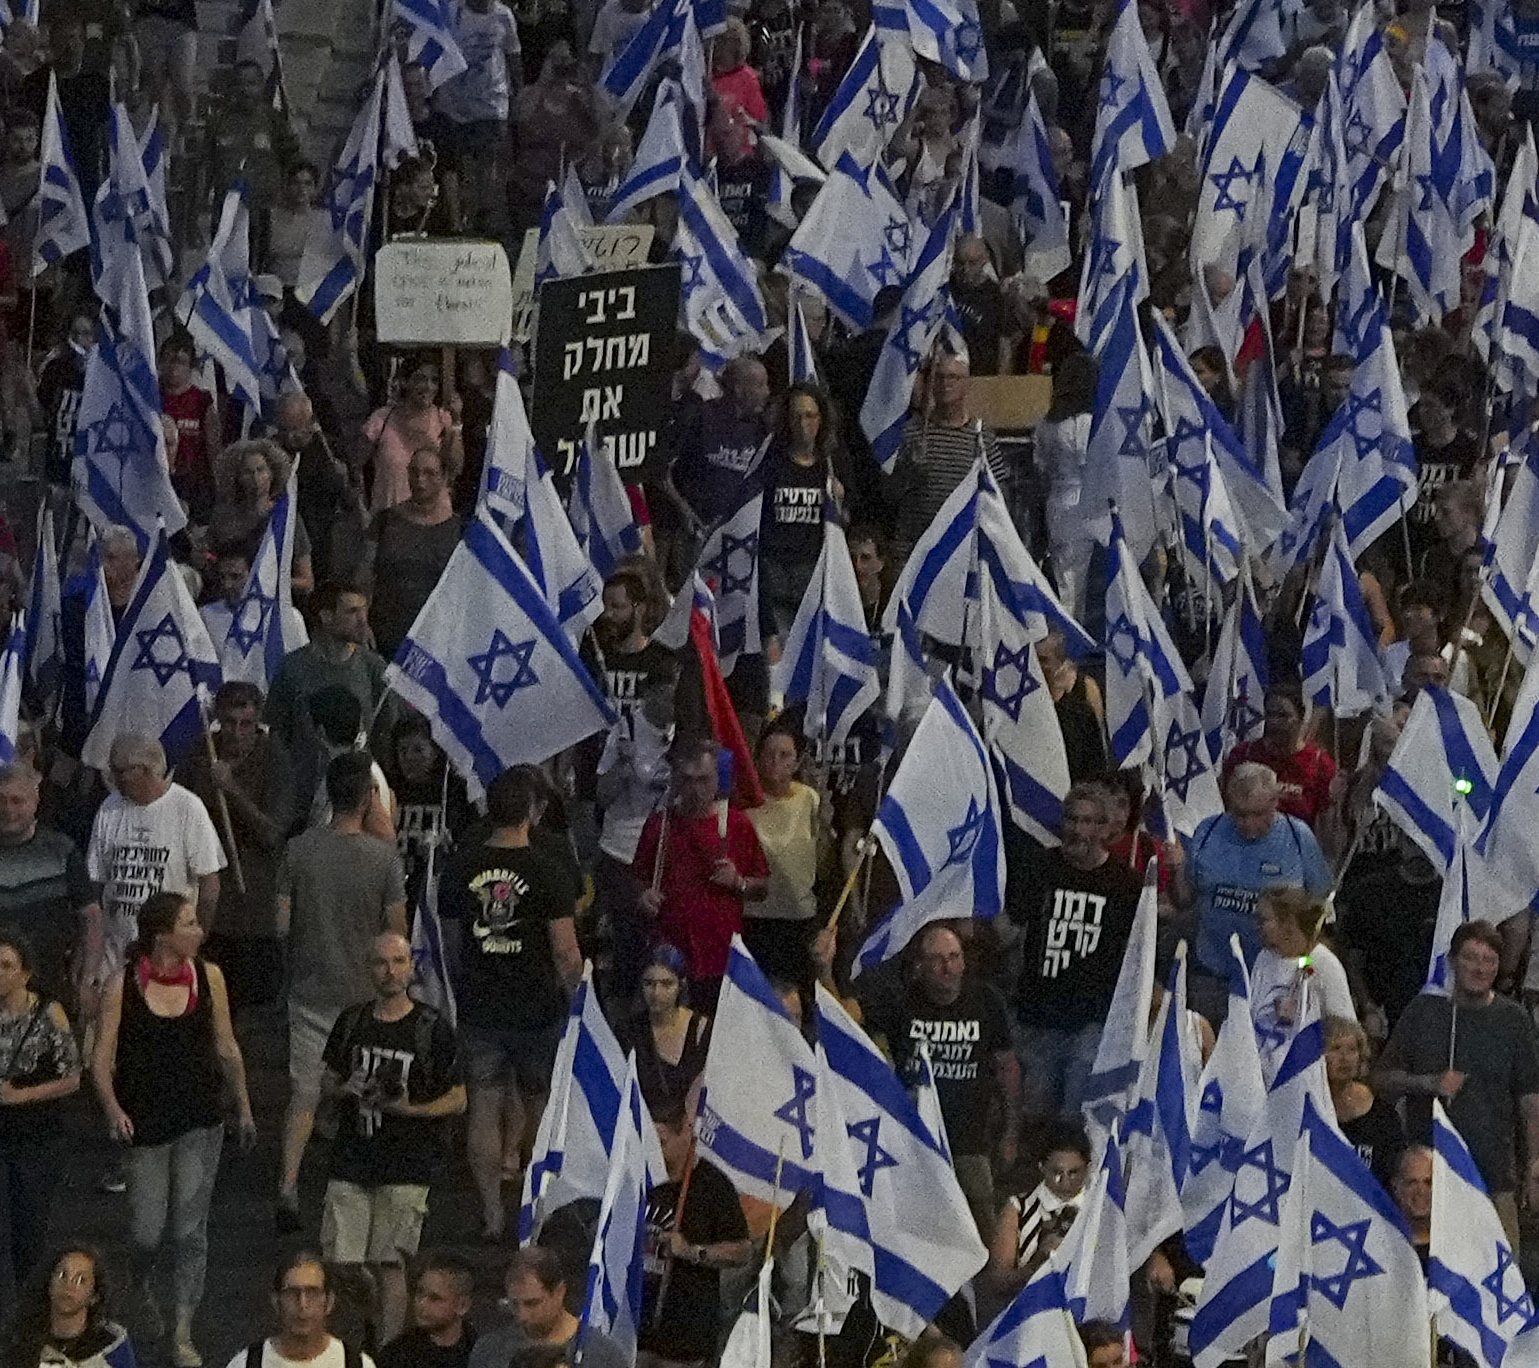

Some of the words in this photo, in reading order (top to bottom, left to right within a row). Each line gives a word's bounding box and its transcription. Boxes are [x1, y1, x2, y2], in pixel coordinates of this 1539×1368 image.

[577, 284, 636, 324] ביבי
[562, 331, 650, 377] מחלק
[579, 383, 624, 424] את
[556, 429, 657, 476] ישרל
[1054, 888, 1107, 926] דמו
[1048, 917, 1103, 959] קרט
[1042, 948, 1071, 979] יה
[909, 1020, 981, 1043] נאמנים
